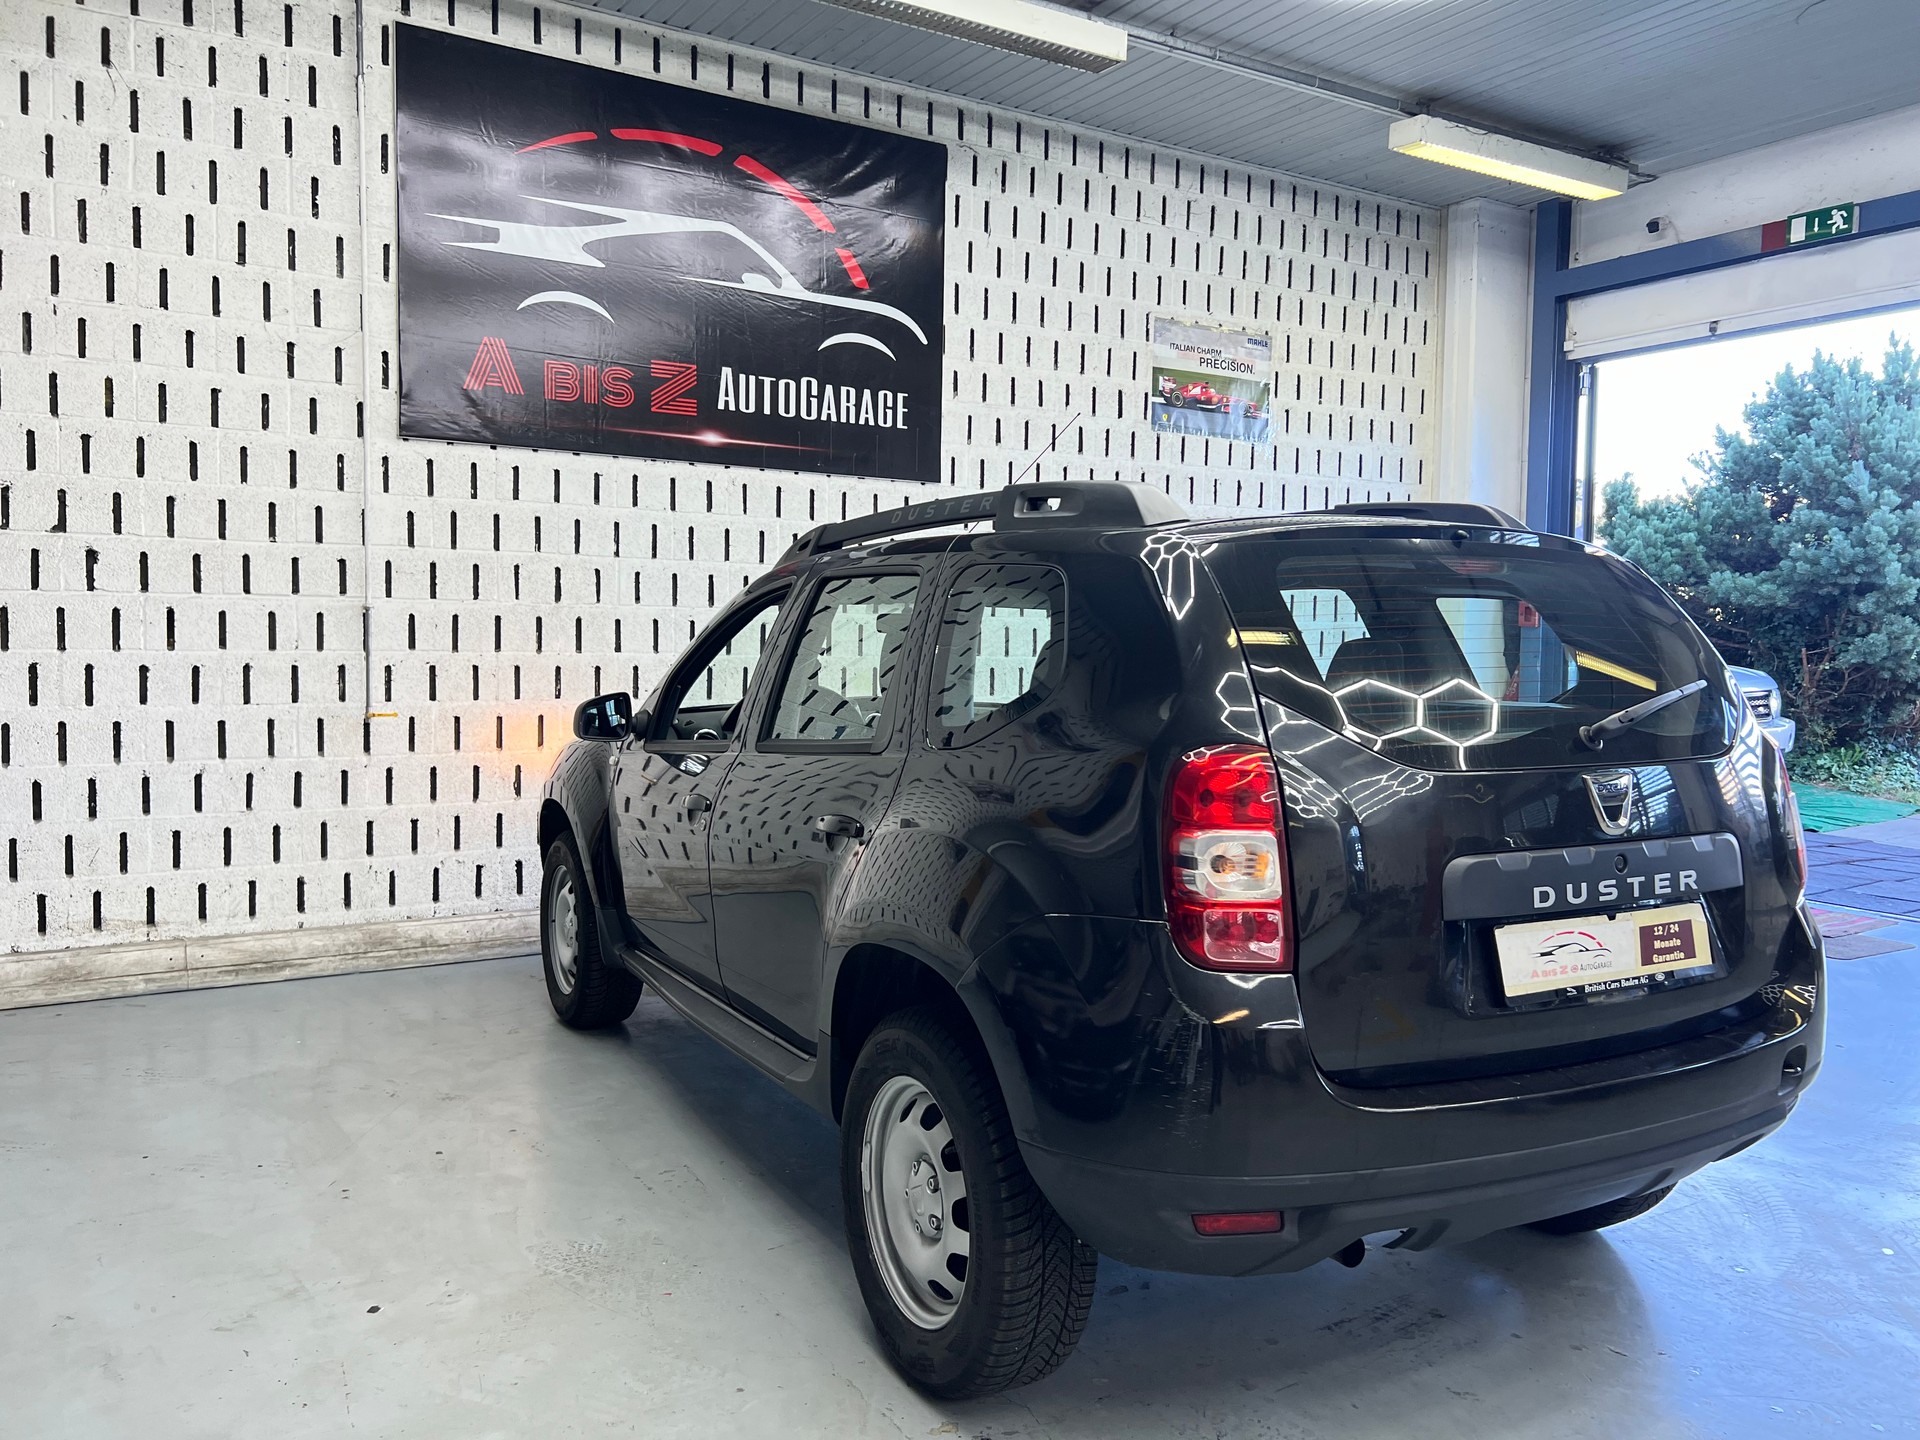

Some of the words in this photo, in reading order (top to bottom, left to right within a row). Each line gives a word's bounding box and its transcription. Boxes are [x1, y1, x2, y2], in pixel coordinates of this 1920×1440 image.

[1169, 342, 1196, 353] ITALIAN
[1247, 338, 1269, 347] MAHLE
[1199, 357, 1256, 375] PRECISION.
[463, 336, 525, 396] A
[650, 360, 698, 416] Z
[891, 496, 994, 525] DUSTER
[1596, 782, 1629, 794] DACIA
[1533, 869, 1699, 909] DUSTER
[1653, 925, 1664, 936] 12
[1669, 923, 1680, 934] 24
[1653, 937, 1682, 949] Monate
[1652, 950, 1686, 963] Garantie
[1530, 969, 1541, 979] A
[1559, 964, 1569, 975] Z
[1584, 981, 1606, 993] British
[1606, 979, 1621, 990] Cars
[1620, 977, 1639, 988] Baden
[1639, 975, 1649, 985] AG
